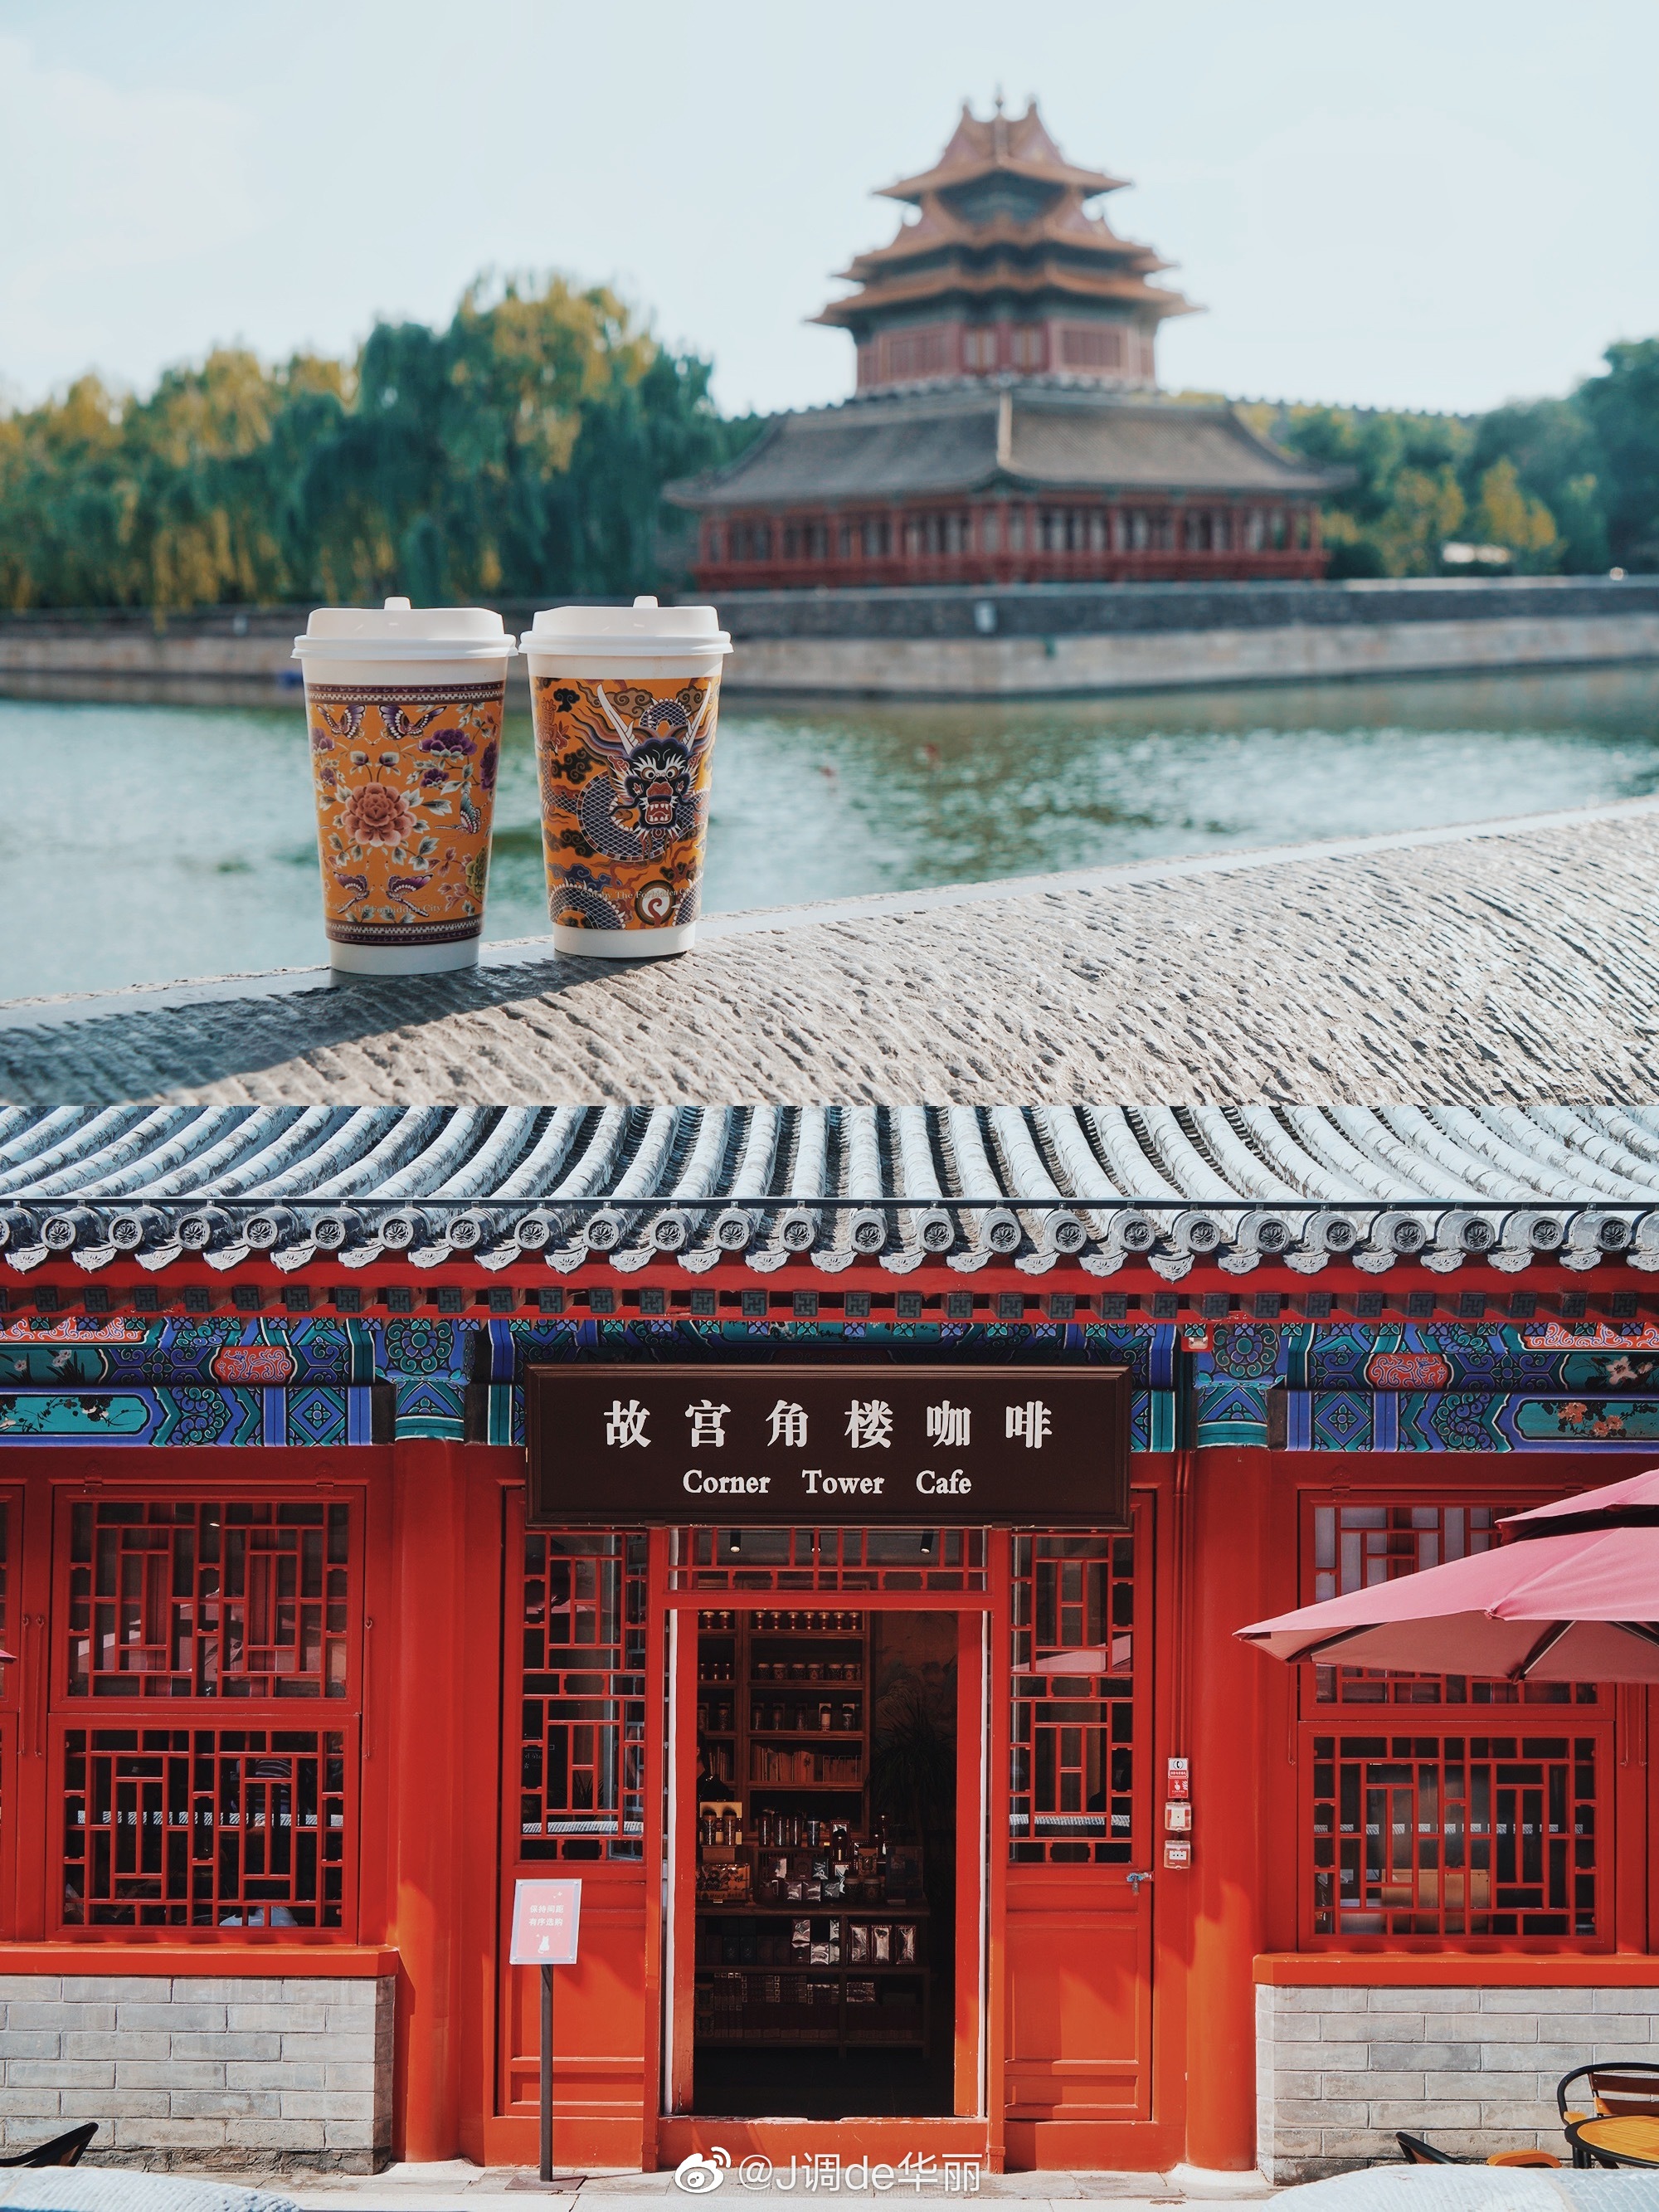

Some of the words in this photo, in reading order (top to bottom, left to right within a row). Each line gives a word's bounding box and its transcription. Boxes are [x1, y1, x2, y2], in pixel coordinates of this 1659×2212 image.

[636, 889, 678, 899] Forbidden
[423, 904, 441, 913] City
[604, 1399, 1053, 1449] 故宫角楼咖啡
[683, 1470, 771, 1494] Corner
[801, 1469, 885, 1495] Tower
[916, 1469, 972, 1494] Cafe
